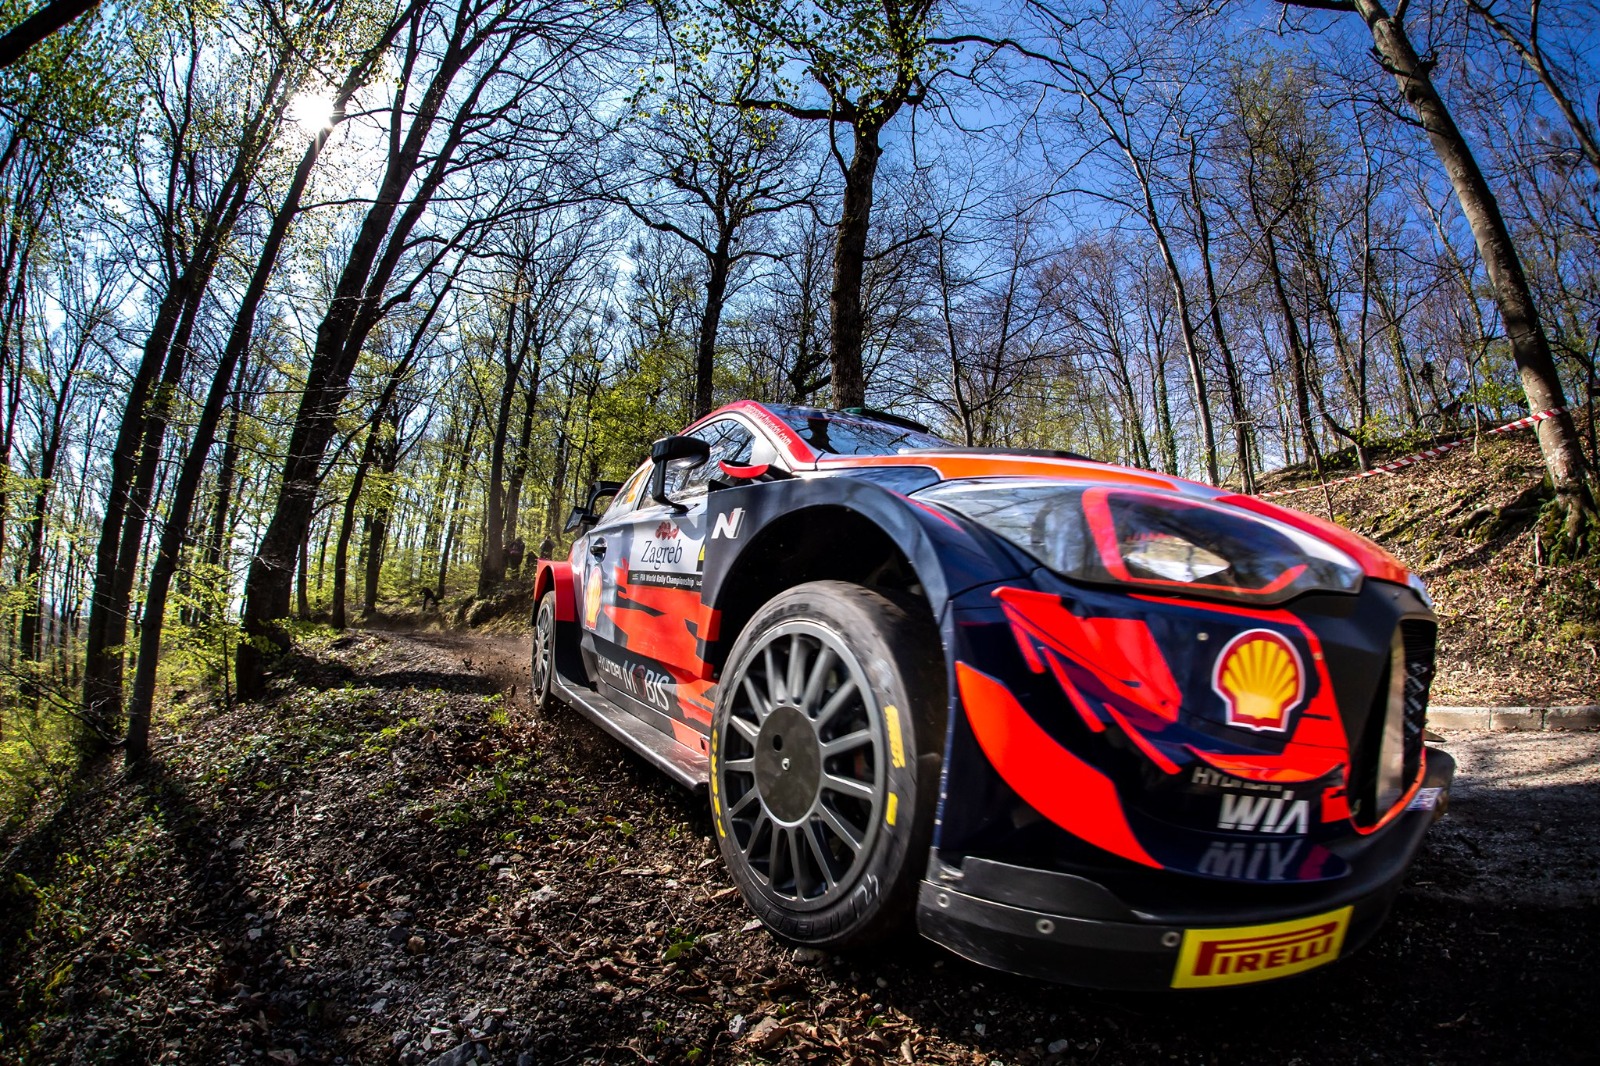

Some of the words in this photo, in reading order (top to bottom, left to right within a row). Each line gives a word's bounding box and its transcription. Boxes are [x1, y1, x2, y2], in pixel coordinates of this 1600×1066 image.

[640, 539, 683, 570] Zagreb
[646, 574, 657, 582] World
[656, 575, 666, 585] Rally
[666, 575, 695, 588] Championship
[622, 660, 670, 711] MOBIS
[1192, 921, 1340, 976] PIRELLI
